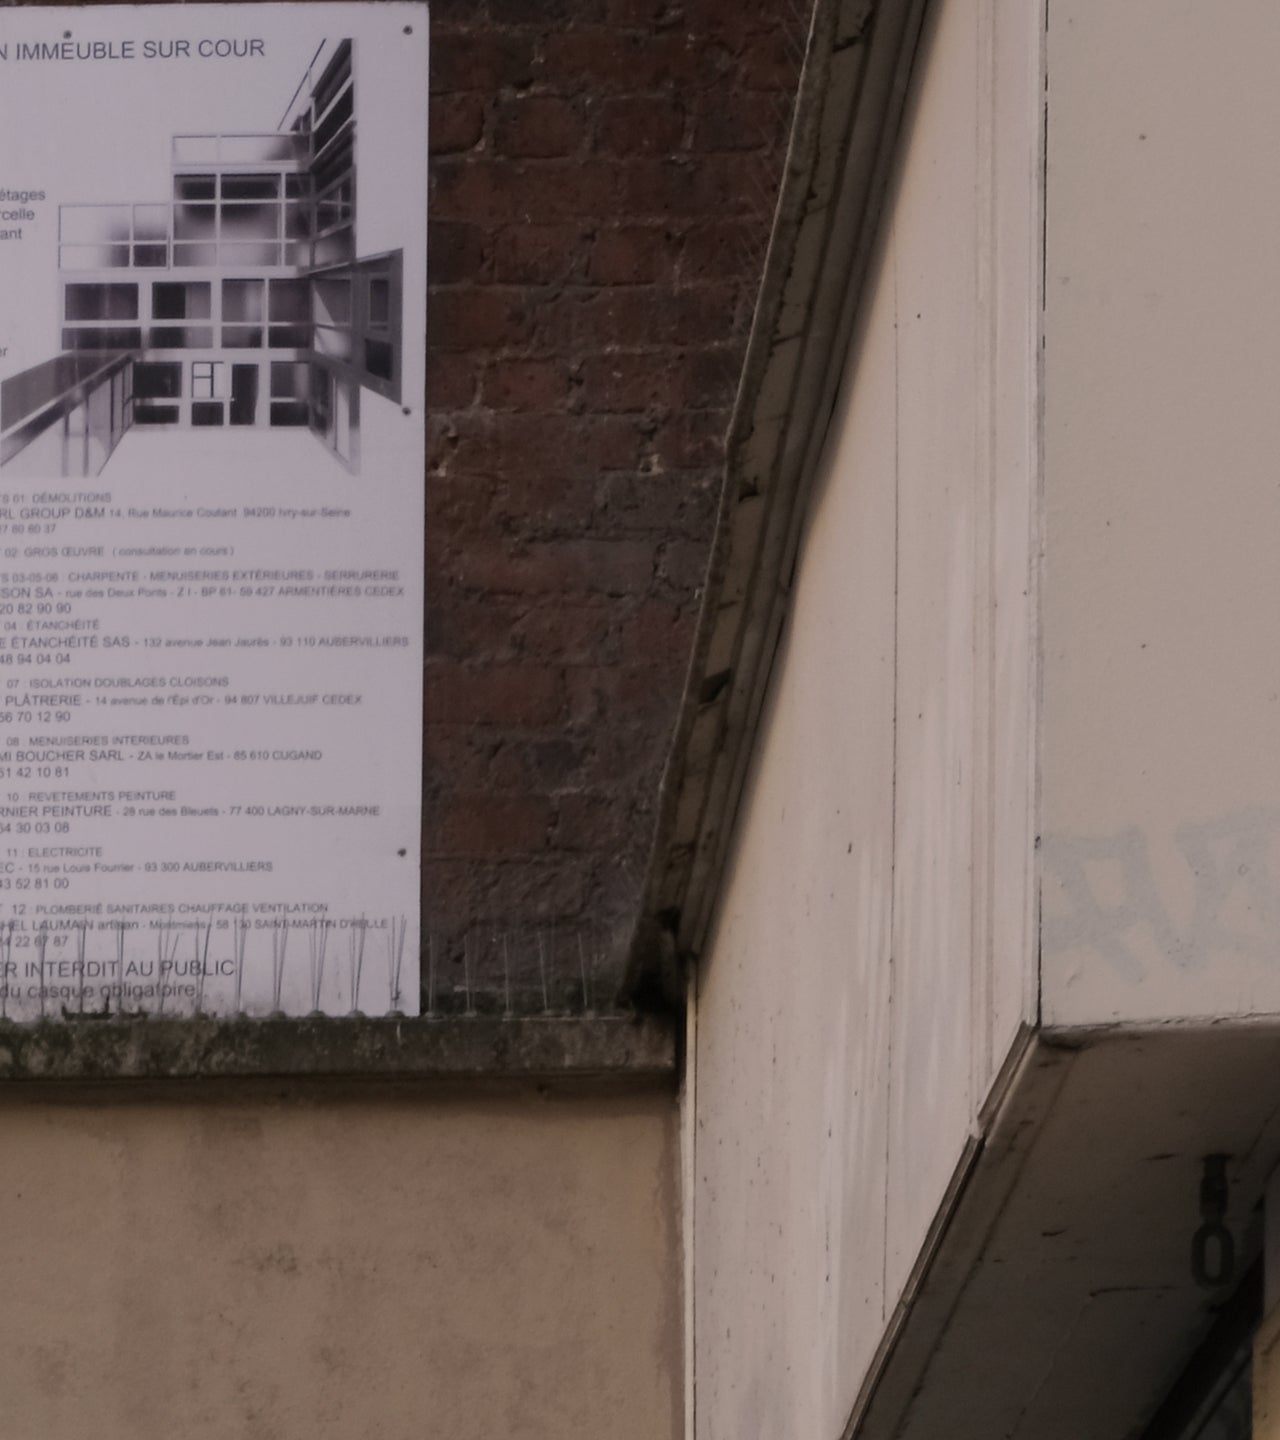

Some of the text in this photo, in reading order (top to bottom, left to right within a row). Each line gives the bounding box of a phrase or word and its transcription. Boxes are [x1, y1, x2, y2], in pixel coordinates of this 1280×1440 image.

[16, 41, 135, 60] IMMEUBLE
[143, 40, 190, 58] SUR
[198, 39, 265, 57] COUR
[20, 507, 71, 519] GROUP
[75, 507, 105, 519] D&M
[35, 587, 53, 599] SA
[11, 636, 98, 648] ÉTANCHÉITÉ
[102, 636, 130, 648] SAS
[16, 750, 85, 762] BOUCHER
[89, 750, 123, 761] SARL
[42, 805, 111, 817] PEINTURE
[25, 961, 119, 978] INTERDIT
[126, 961, 153, 977] AU
[161, 960, 234, 976] PUBLIC
[0, 982, 22, 999] du
[27, 984, 93, 1002] casque
